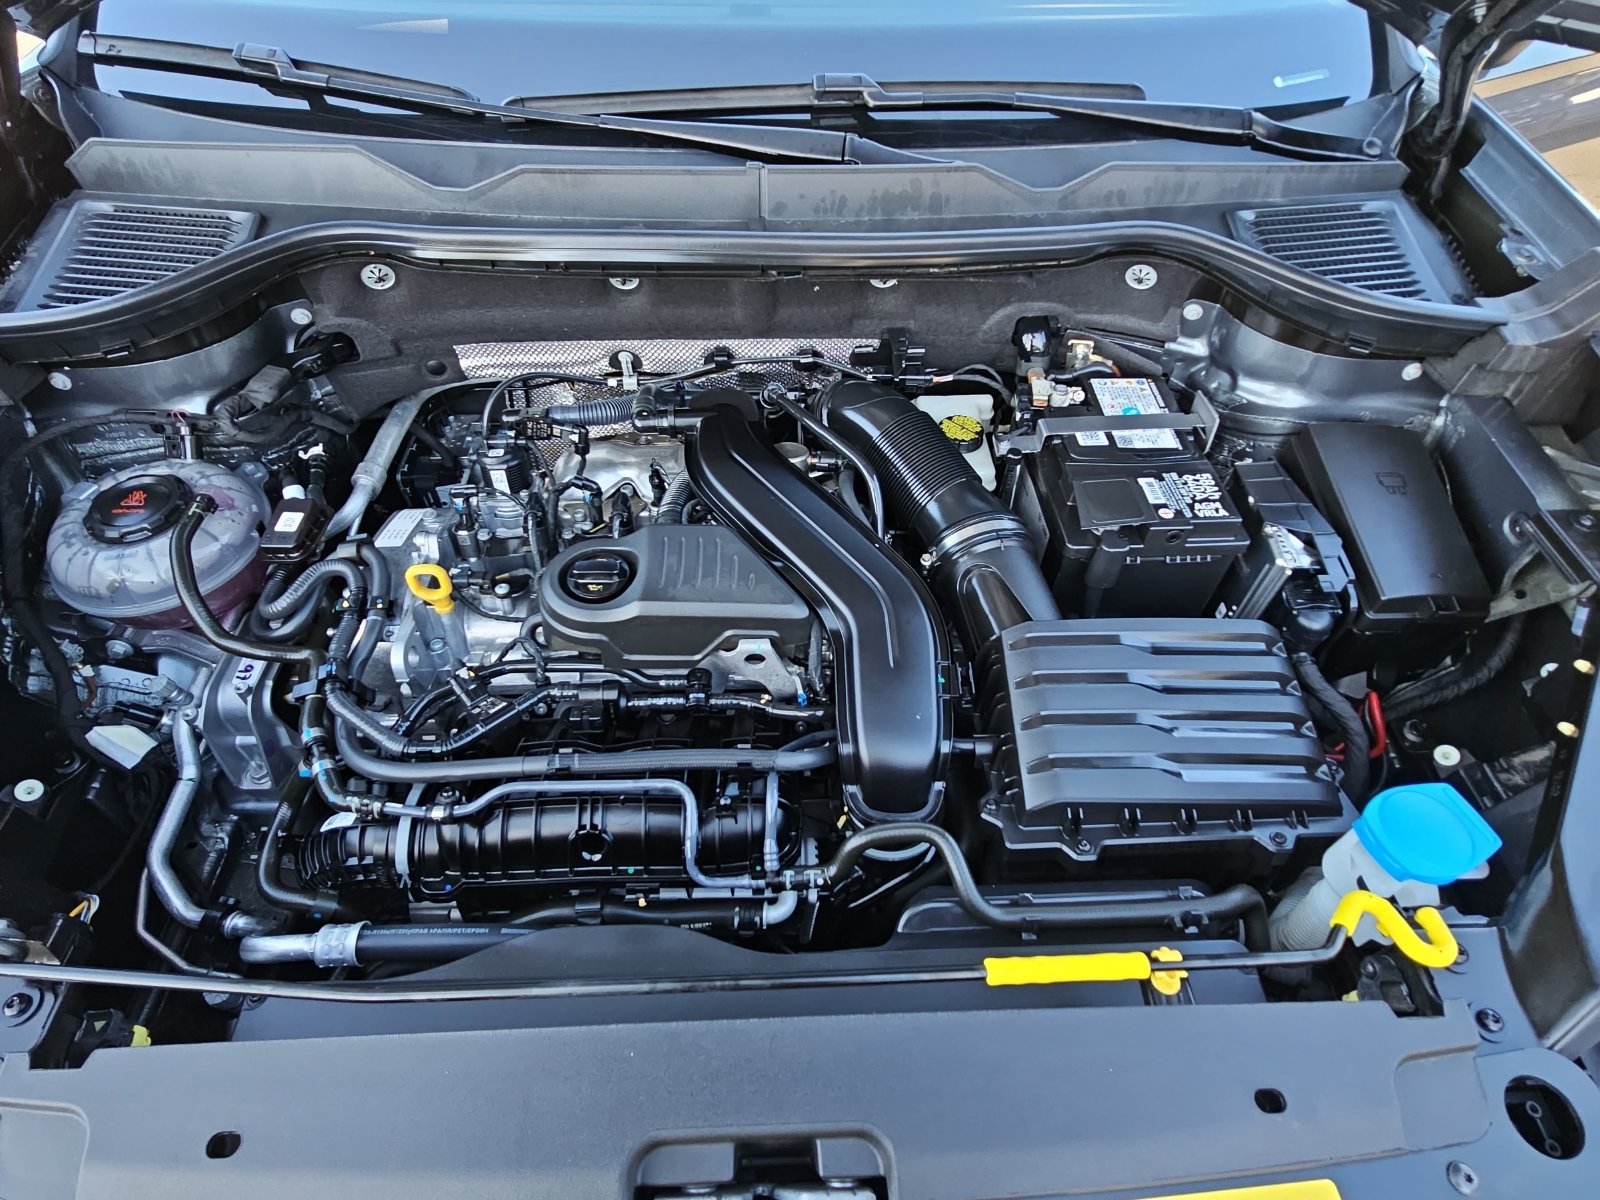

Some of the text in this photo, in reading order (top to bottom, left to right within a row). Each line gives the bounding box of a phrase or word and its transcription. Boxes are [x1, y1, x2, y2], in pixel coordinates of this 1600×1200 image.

[1182, 474, 1206, 500] 640A
[1196, 473, 1222, 500] 58Ah
[1193, 508, 1230, 518] VRLA
[1194, 501, 1223, 509] AGM
